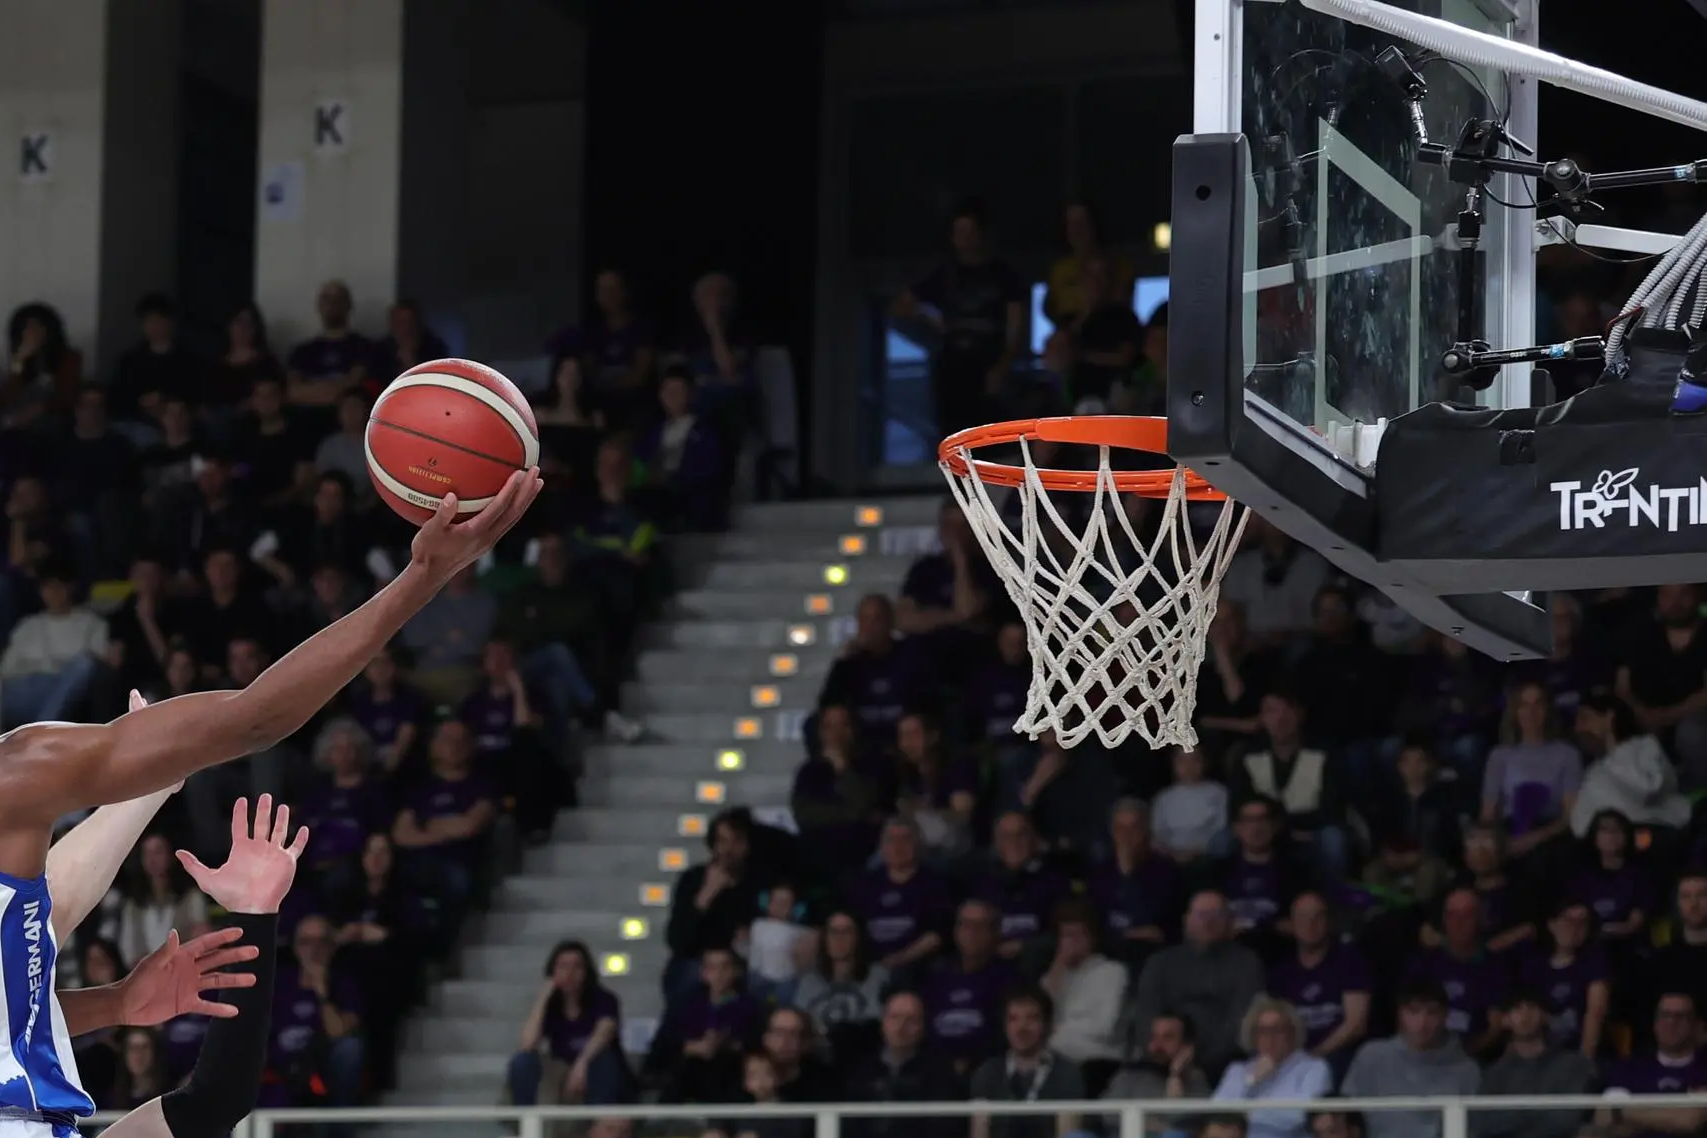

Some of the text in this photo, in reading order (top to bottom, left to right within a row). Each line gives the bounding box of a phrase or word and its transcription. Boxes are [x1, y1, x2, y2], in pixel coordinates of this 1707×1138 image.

[315, 104, 343, 145] K
[21, 134, 49, 174] K
[1550, 470, 1707, 532] TRENTI
